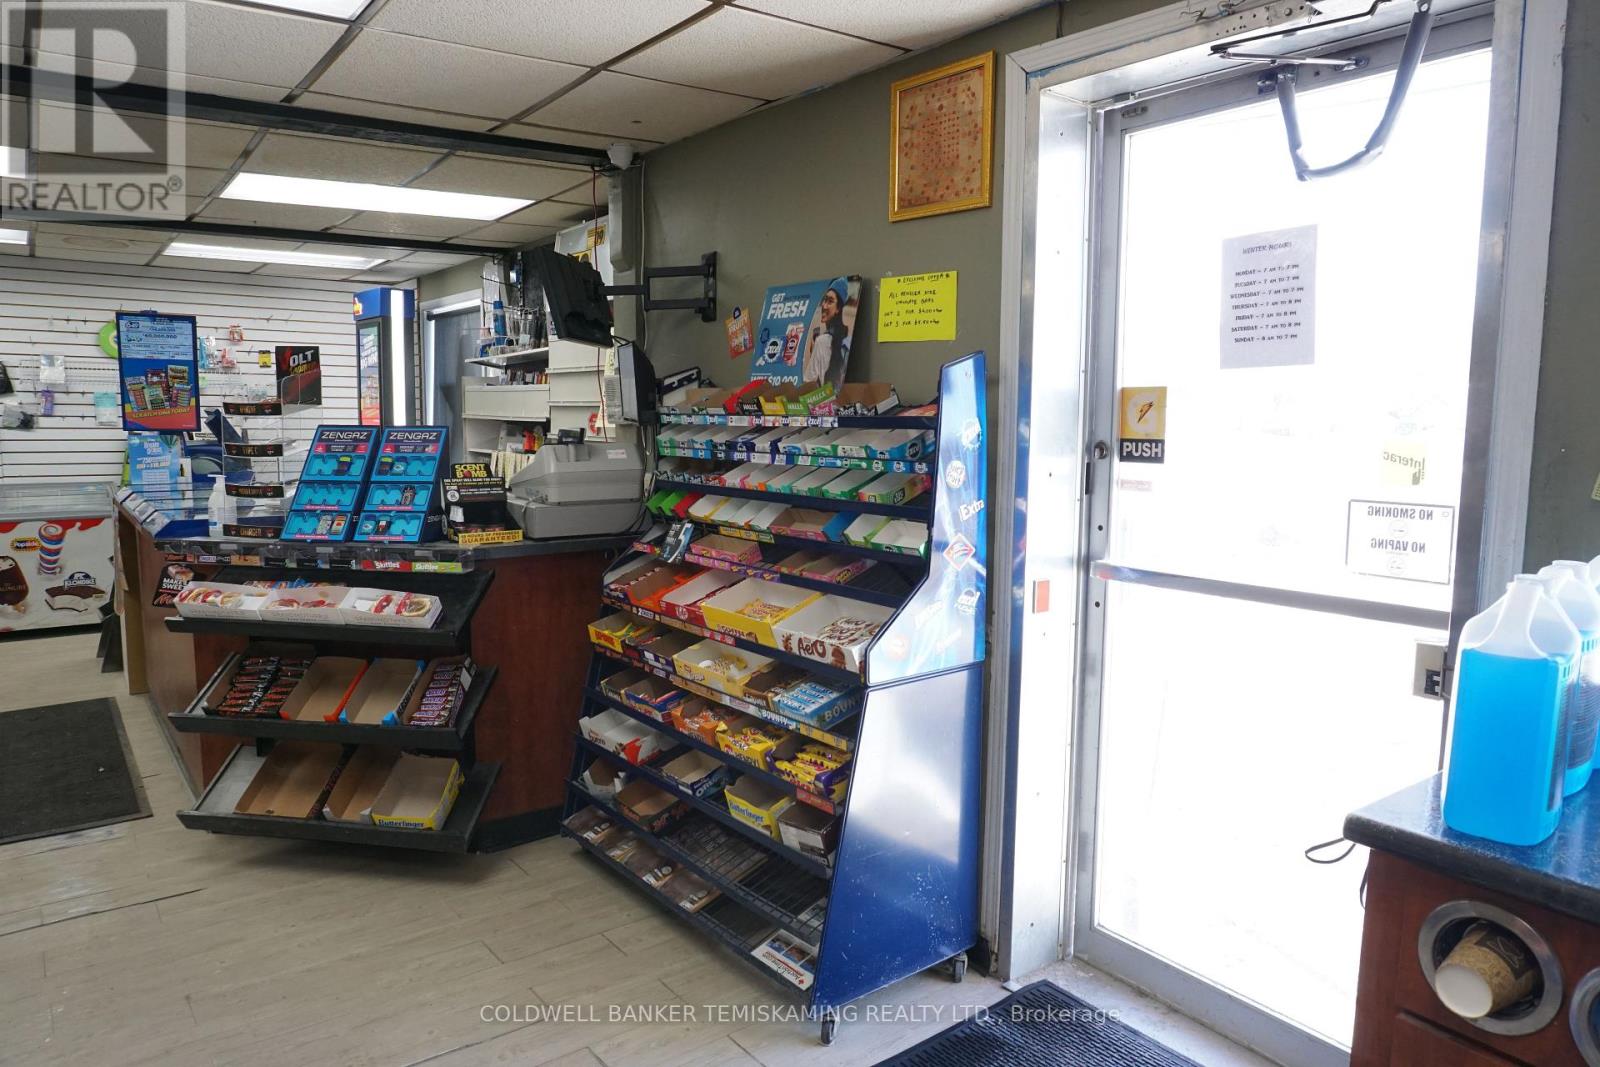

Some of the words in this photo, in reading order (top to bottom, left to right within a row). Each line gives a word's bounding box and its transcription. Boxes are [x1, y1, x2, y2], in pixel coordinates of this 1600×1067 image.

[771, 293, 786, 303] GET
[767, 299, 810, 320] FRESH
[321, 431, 369, 440] ZENGAZ
[389, 432, 438, 440] ZENGAZ
[1122, 441, 1162, 458] PUSH
[454, 463, 486, 471] SCENT
[959, 500, 985, 521] Extra
[461, 534, 520, 544] GUARANTEED!
[374, 560, 400, 569] Skittles
[414, 562, 439, 570] Skittles
[762, 709, 788, 726] BOUNTY
